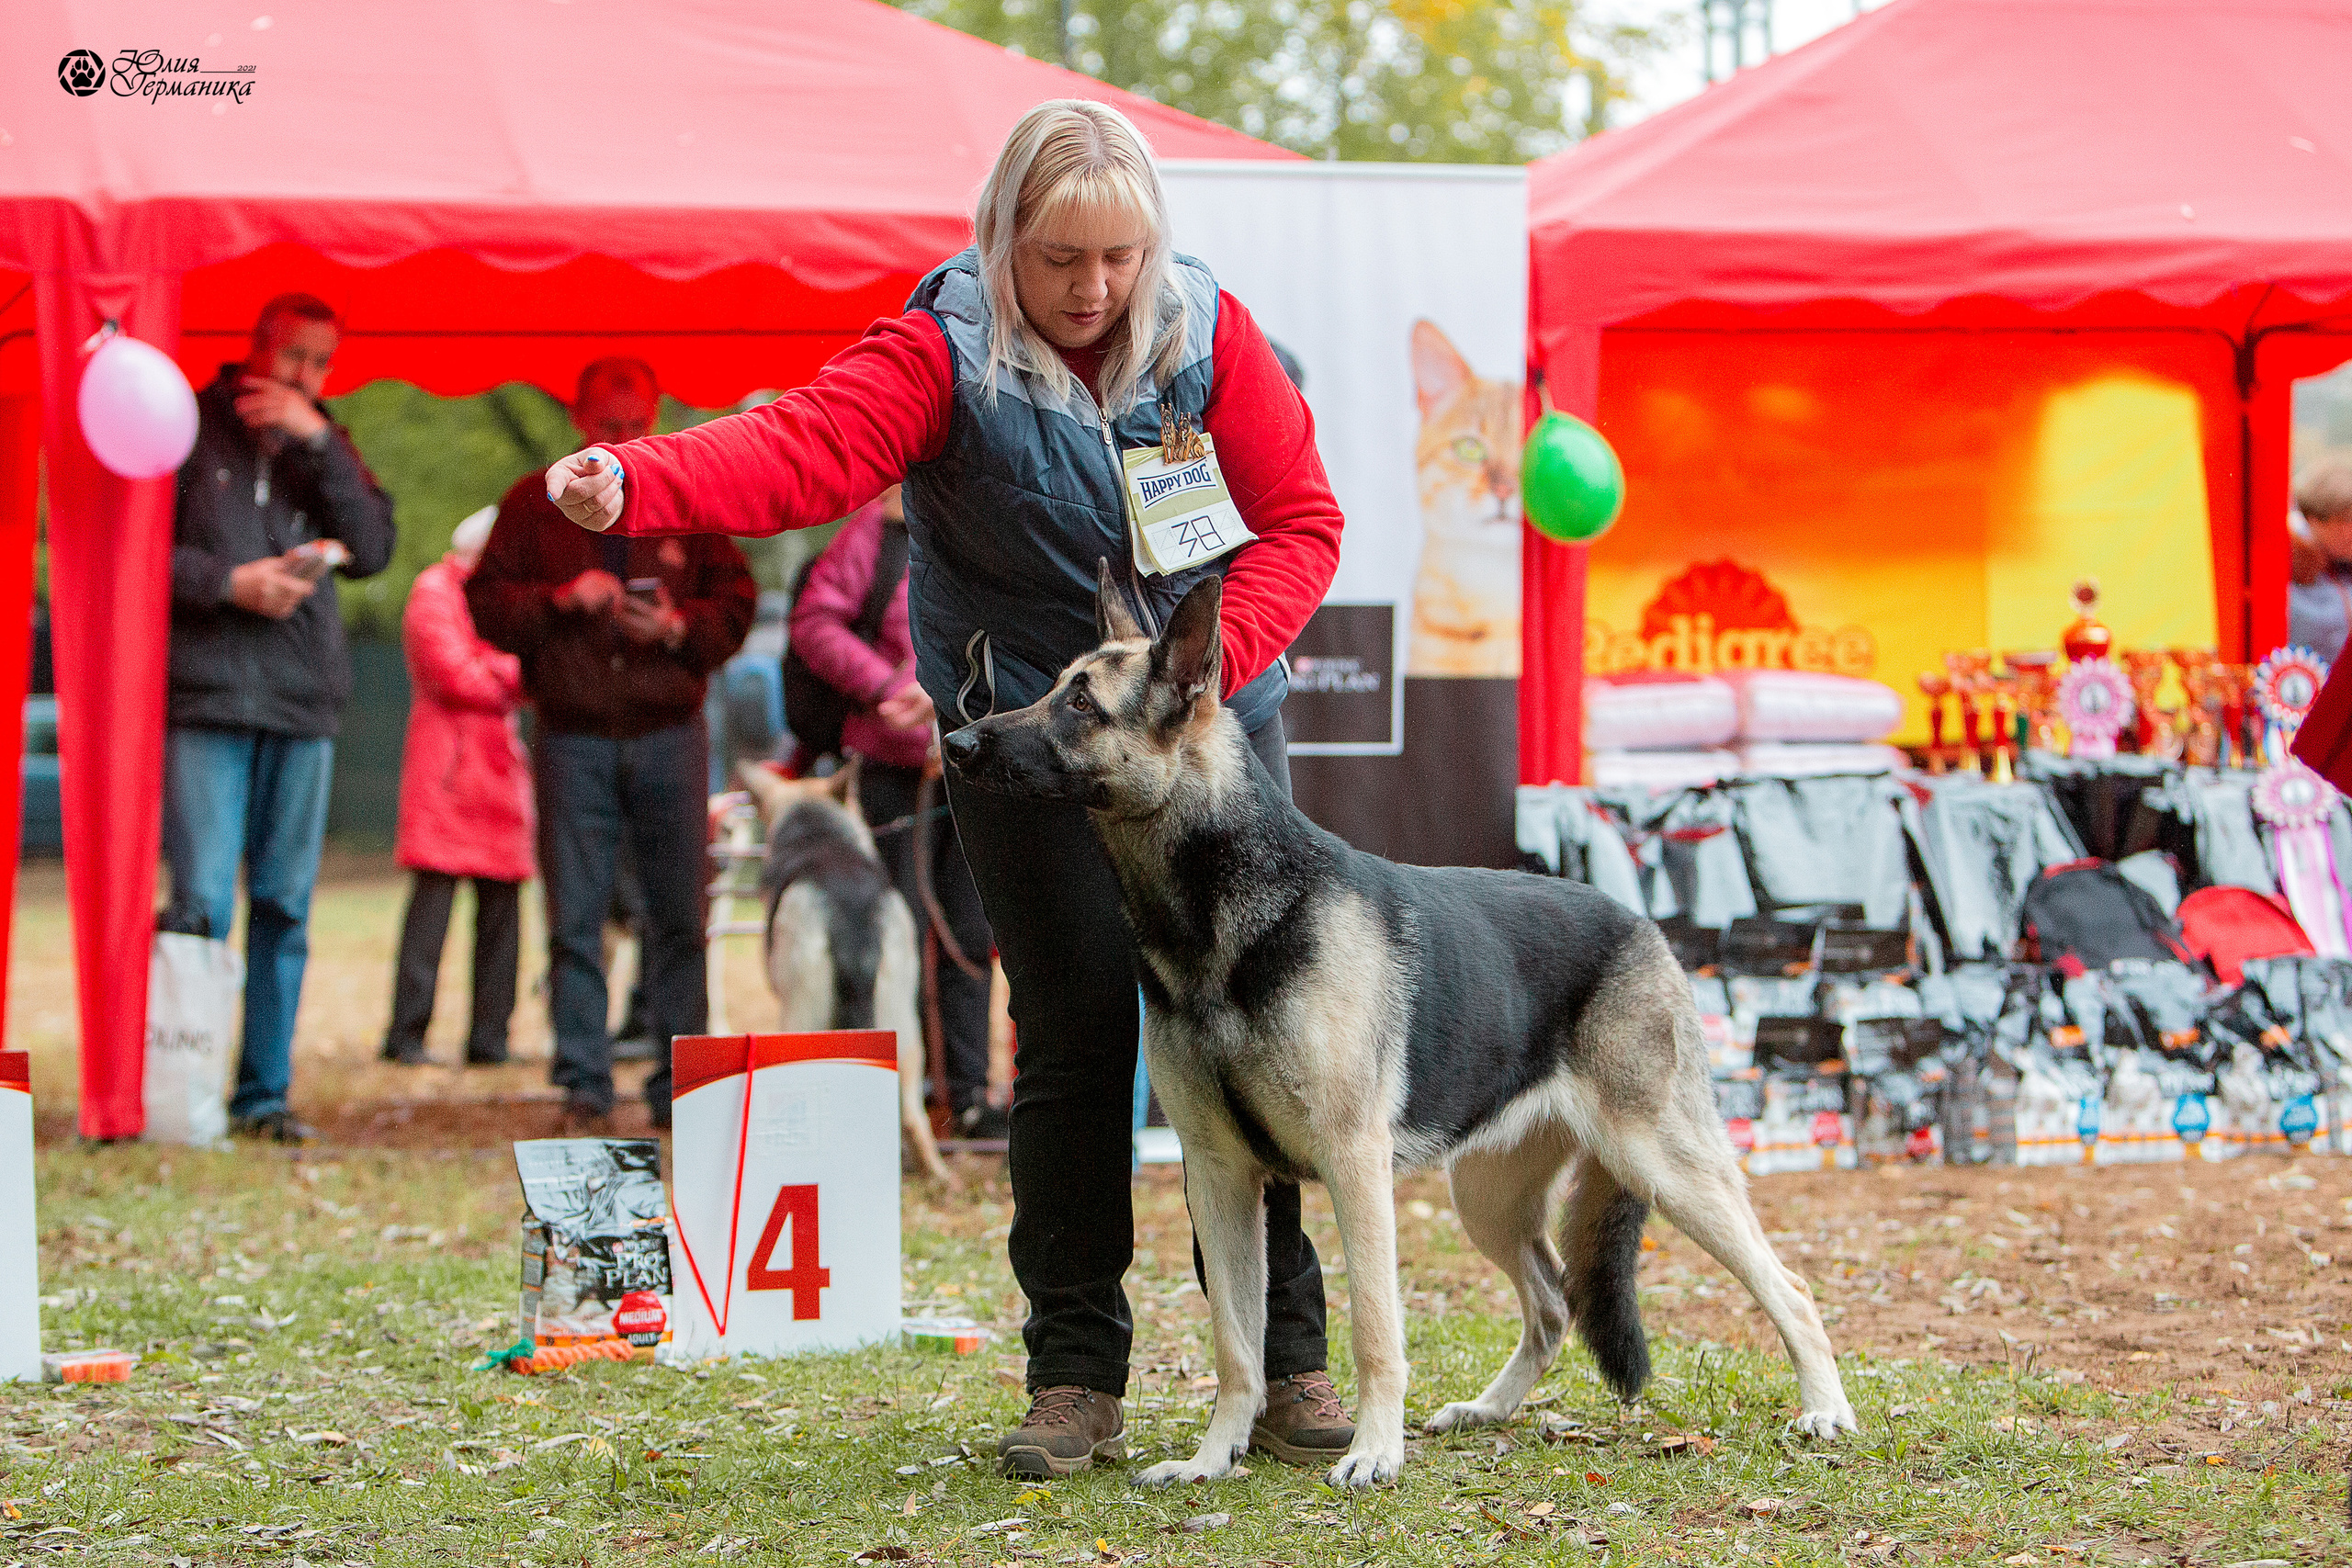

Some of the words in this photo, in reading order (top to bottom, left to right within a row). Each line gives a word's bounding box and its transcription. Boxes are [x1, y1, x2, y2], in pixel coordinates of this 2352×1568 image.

[1139, 472, 1182, 503] HAPPY
[1182, 463, 1212, 486] DOG
[1170, 514, 1227, 558] 38
[616, 1250, 662, 1269] PRO
[747, 1183, 831, 1321] 4
[605, 1267, 669, 1289] PLAN
[618, 1309, 662, 1325] MEDIUM
